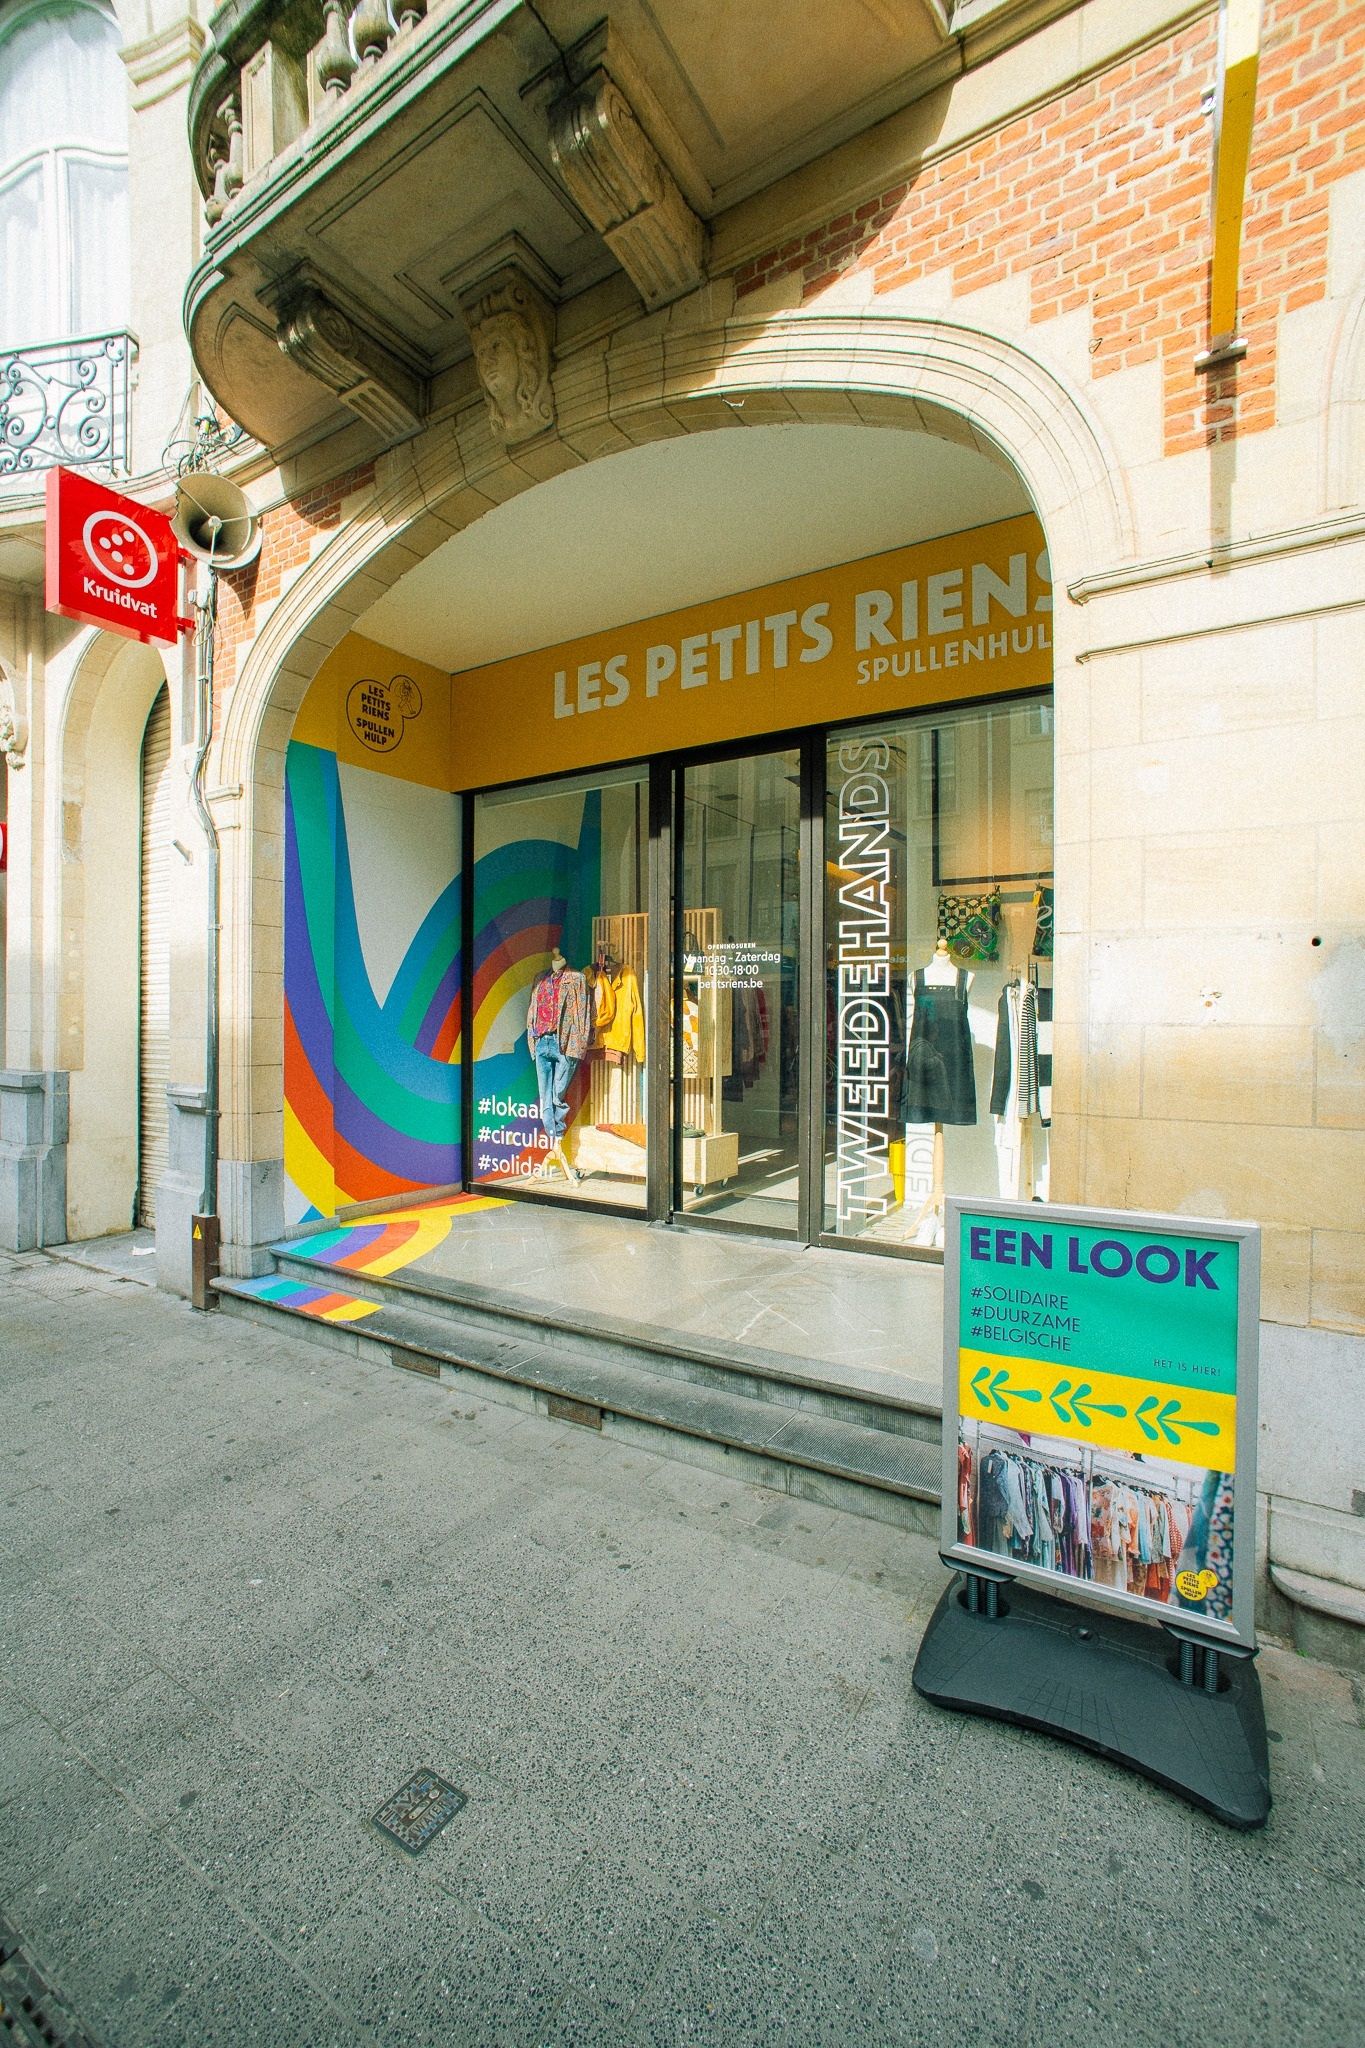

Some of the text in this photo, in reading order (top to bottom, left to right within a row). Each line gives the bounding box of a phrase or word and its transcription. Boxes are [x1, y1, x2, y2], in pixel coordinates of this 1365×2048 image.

[83, 576, 158, 619] Kruidvat
[553, 654, 631, 719] LES
[645, 602, 834, 698] PETITS
[856, 623, 1054, 686] SPULLENHUL
[361, 693, 391, 711] PETITS
[368, 685, 384, 698] LES
[361, 704, 390, 721] RIENS
[356, 718, 395, 738] SPULLEN
[364, 731, 387, 746] HULP
[735, 951, 780, 963] Zaterdag
[698, 978, 763, 989] pettsriens.be
[837, 737, 890, 1221] TWEEDEHANDS
[478, 1125, 562, 1150] #circulair
[478, 1154, 556, 1177] #solidair
[970, 1226, 1220, 1291] EEN LOOK
[971, 1285, 1069, 1311] #SOLIDAIRE
[971, 1305, 1081, 1333] #DUURZAME
[971, 1326, 1072, 1352] #BELGISCHE
[1153, 1359, 1221, 1376] HET IS HIER!
[411, 1801, 448, 1833] WATER
